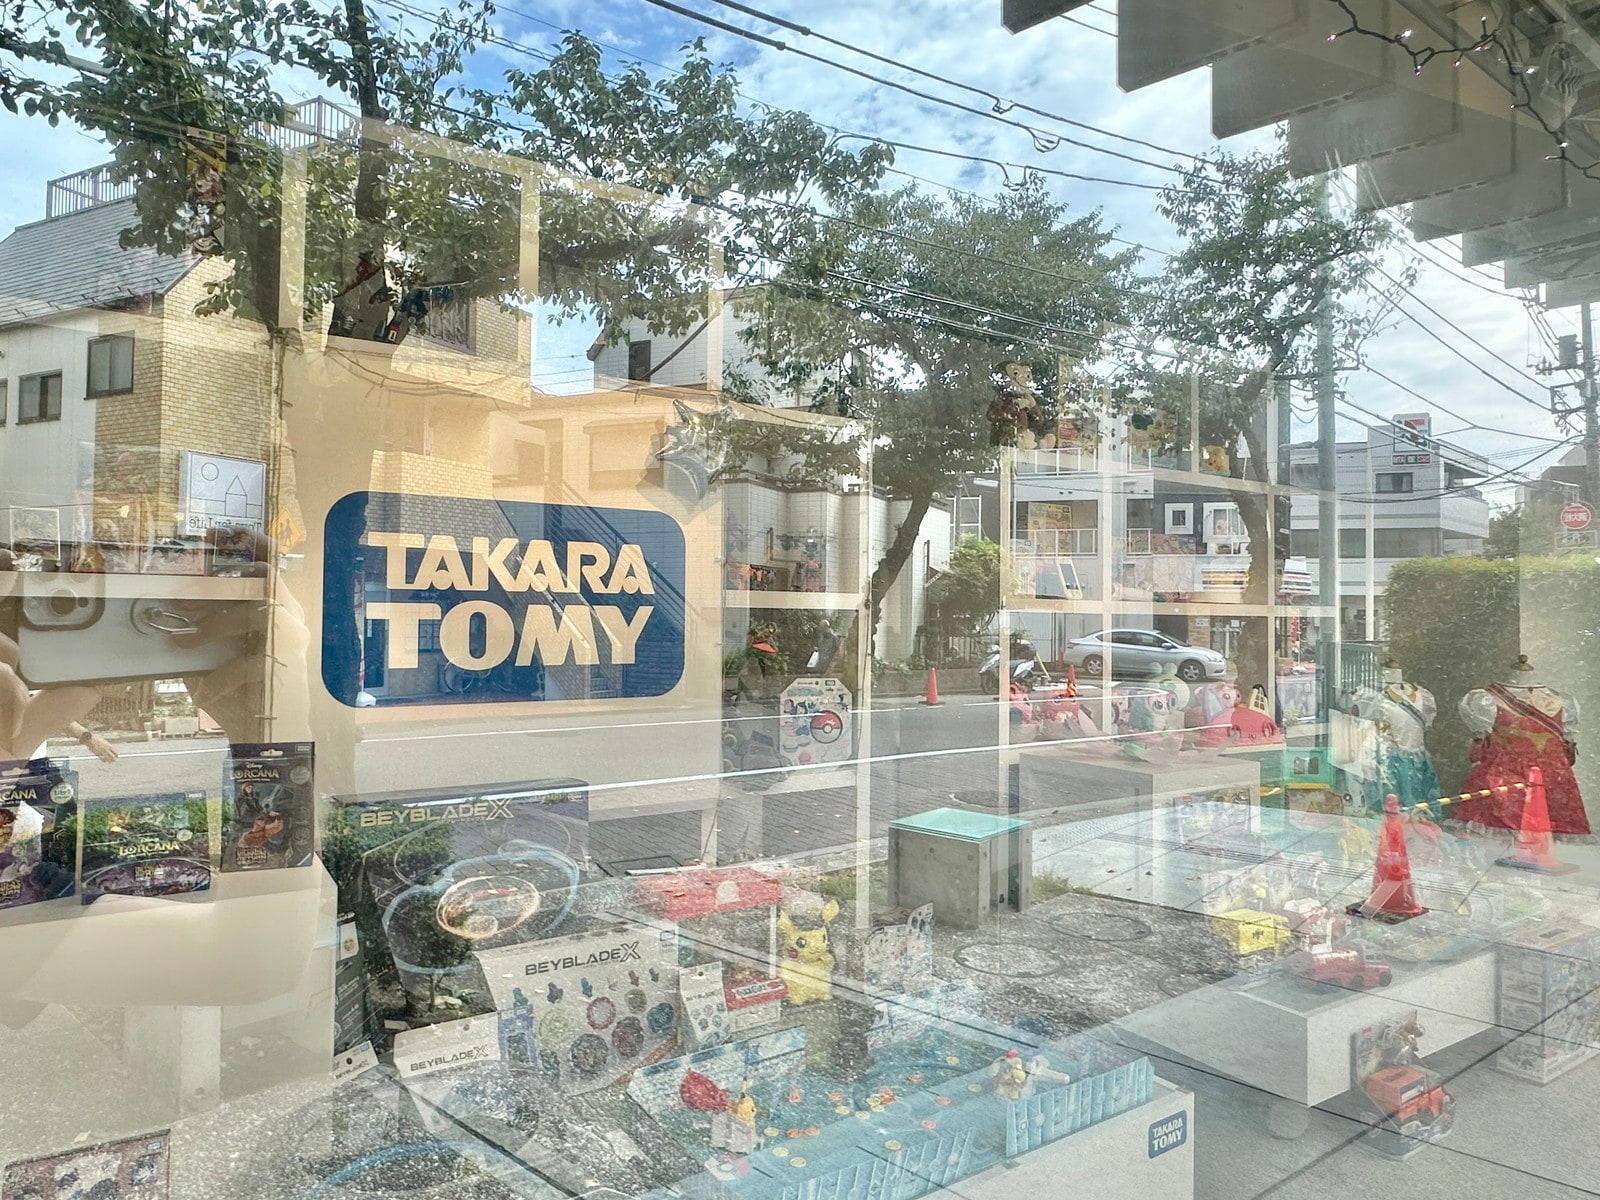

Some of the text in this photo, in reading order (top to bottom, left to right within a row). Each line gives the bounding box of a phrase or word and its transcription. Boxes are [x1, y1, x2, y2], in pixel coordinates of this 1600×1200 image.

[367, 531, 655, 595] TAKARA
[365, 600, 655, 671] TOMY
[230, 769, 280, 780] LORCANA
[0, 788, 37, 802] CANA
[119, 841, 180, 856] LORCANA
[1152, 1117, 1184, 1138] TAKARA
[1152, 1128, 1183, 1151] TOMY
